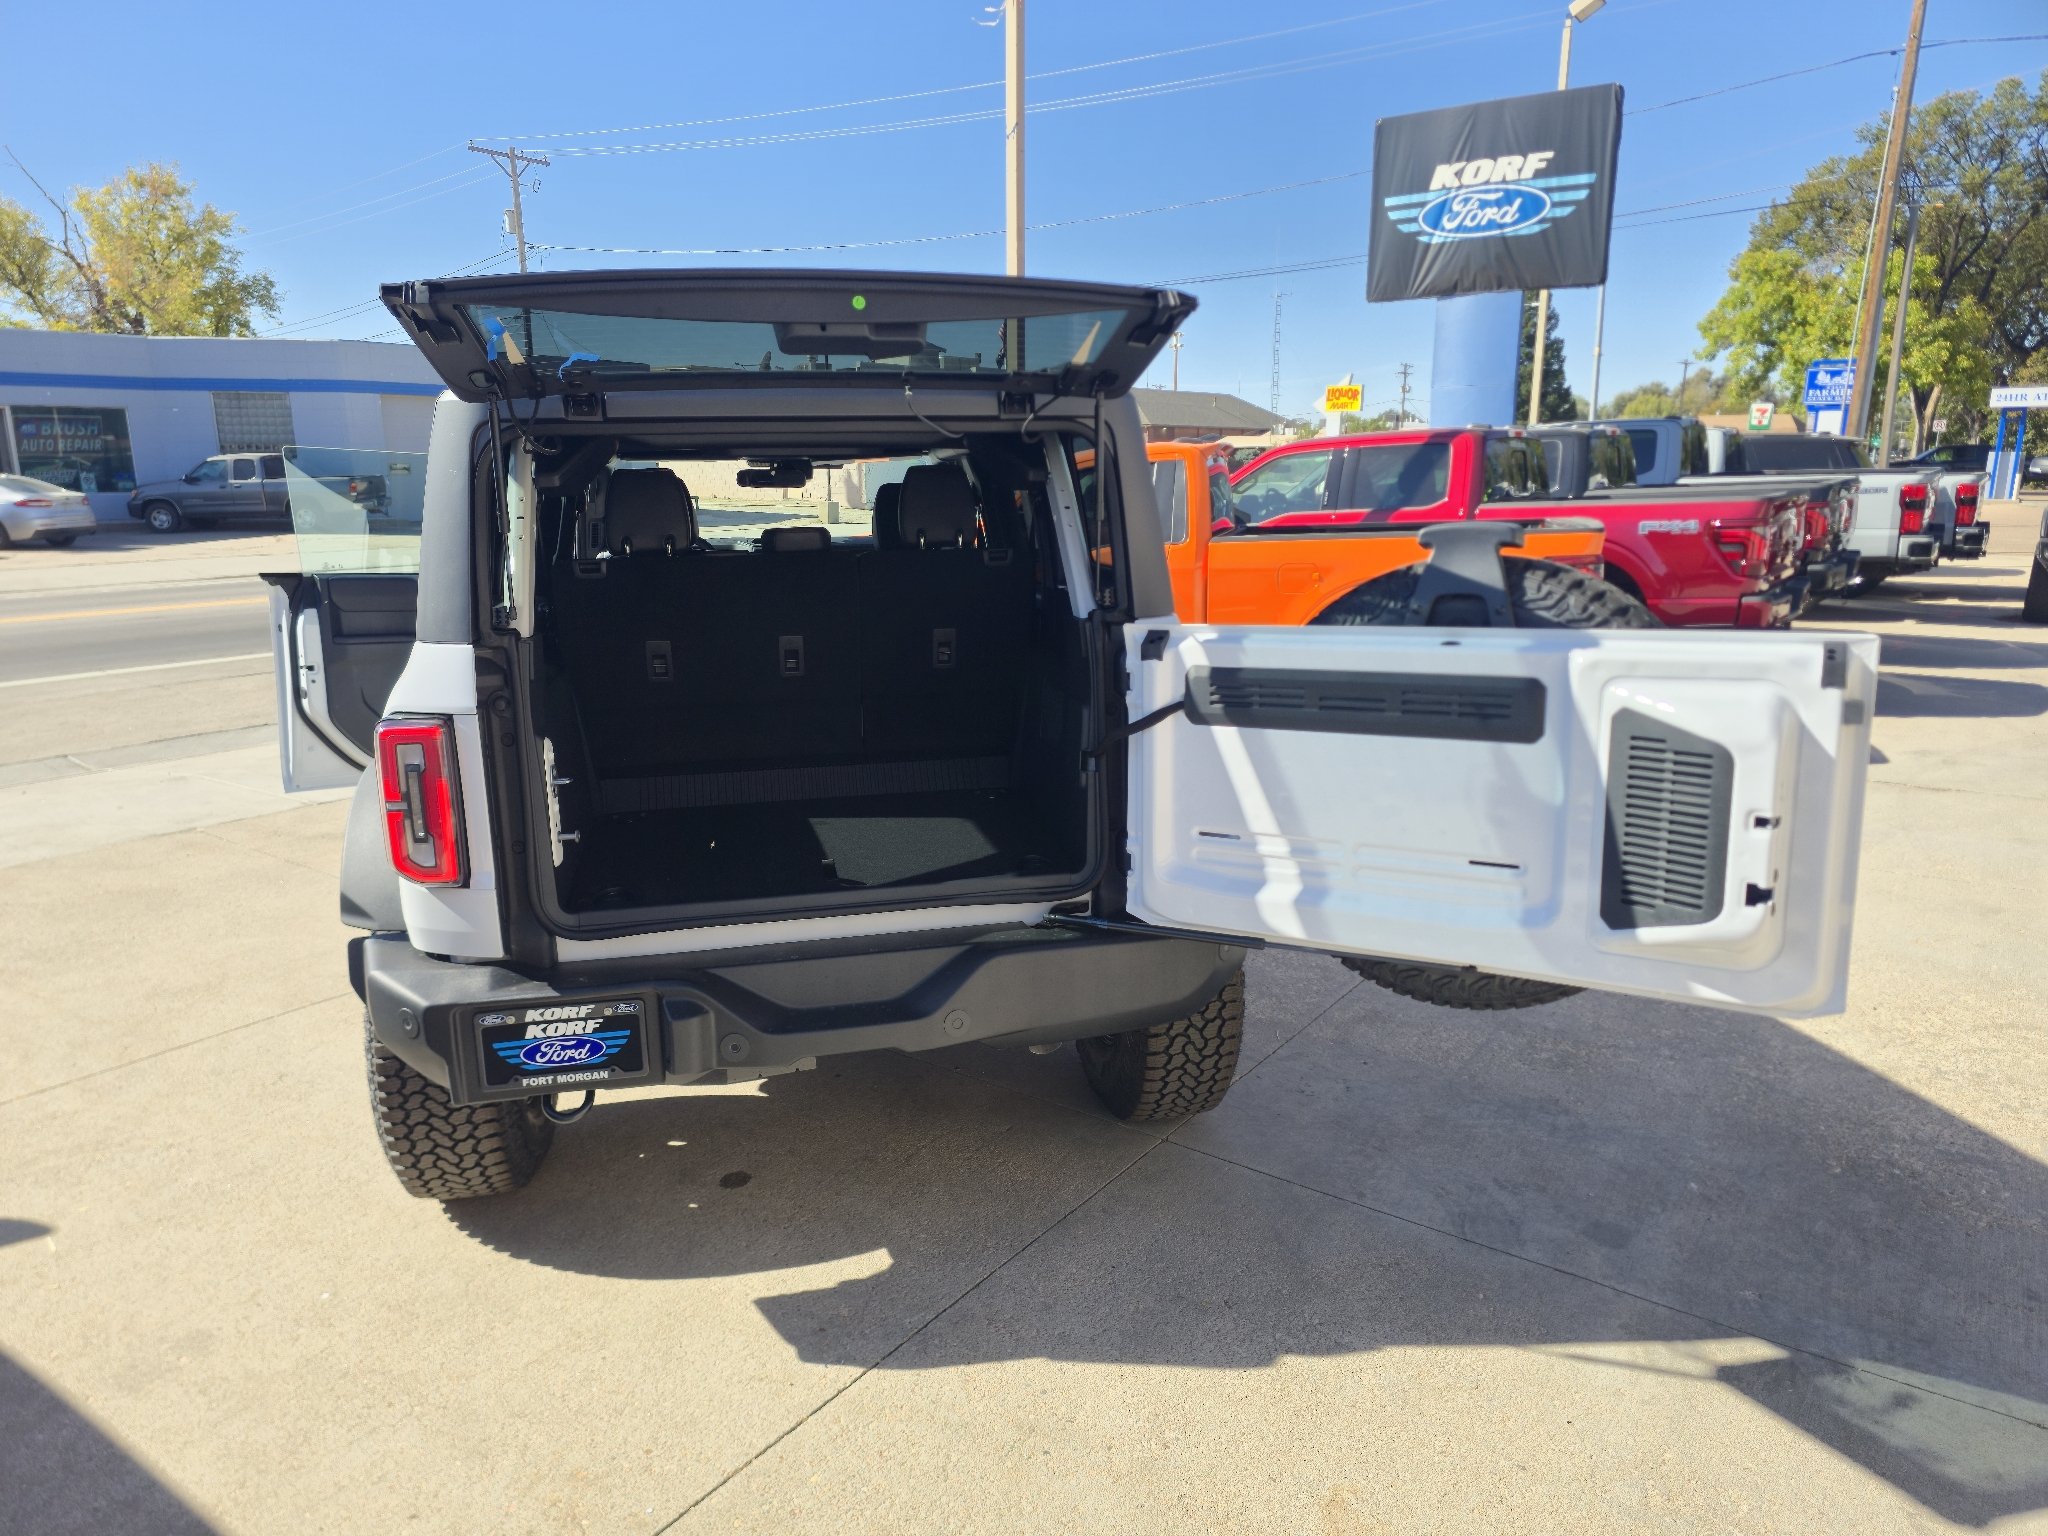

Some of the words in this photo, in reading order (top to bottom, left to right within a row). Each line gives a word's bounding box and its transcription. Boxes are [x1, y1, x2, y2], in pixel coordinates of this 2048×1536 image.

[1429, 151, 1555, 191] KORF
[1442, 191, 1522, 230] Ford
[1326, 388, 1360, 401] LIQUOR
[1808, 389, 1853, 397] FARMER
[1329, 401, 1354, 410] MART
[41, 421, 98, 436] BRUSH
[21, 439, 55, 452] AUTO
[58, 439, 102, 452] REPAIR
[1638, 520, 1699, 535] FX4
[524, 1004, 596, 1023] KORF
[524, 1018, 604, 1040] KORF
[535, 1039, 591, 1063] Ford
[522, 1075, 554, 1087] FORT
[557, 1070, 609, 1084] MORGAN
